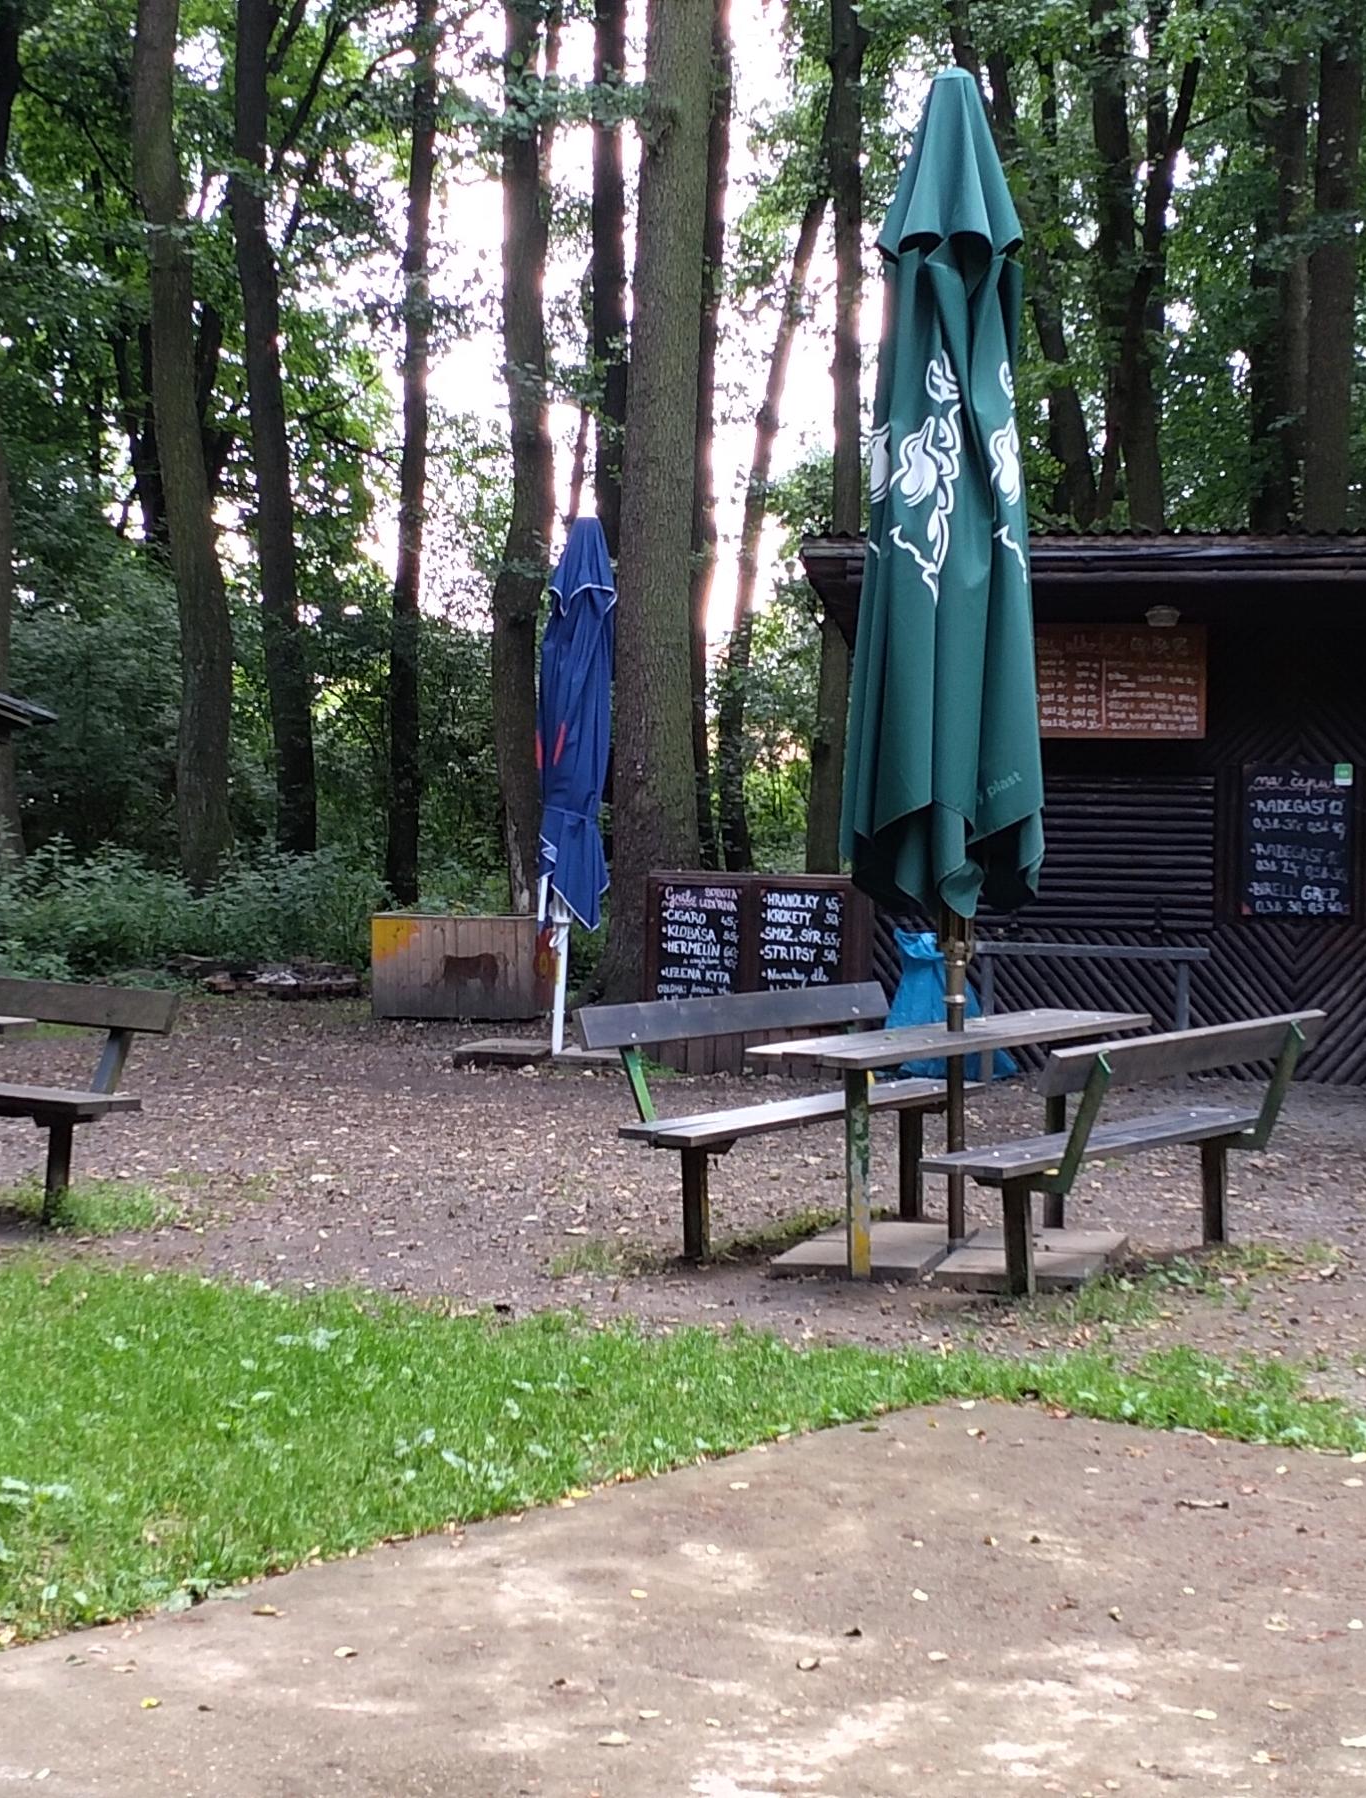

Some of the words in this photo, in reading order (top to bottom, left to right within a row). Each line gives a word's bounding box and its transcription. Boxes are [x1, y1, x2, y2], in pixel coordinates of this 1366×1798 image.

[986, 770, 1023, 799] plast
[1255, 799, 1328, 816] RADEGAST
[766, 892, 820, 910] HRANOLKY
[766, 908, 812, 926] KROKETY
[667, 923, 718, 943] KLOBÁSA
[667, 940, 721, 958] HERMELÍN
[763, 944, 817, 963] STRIPSY
